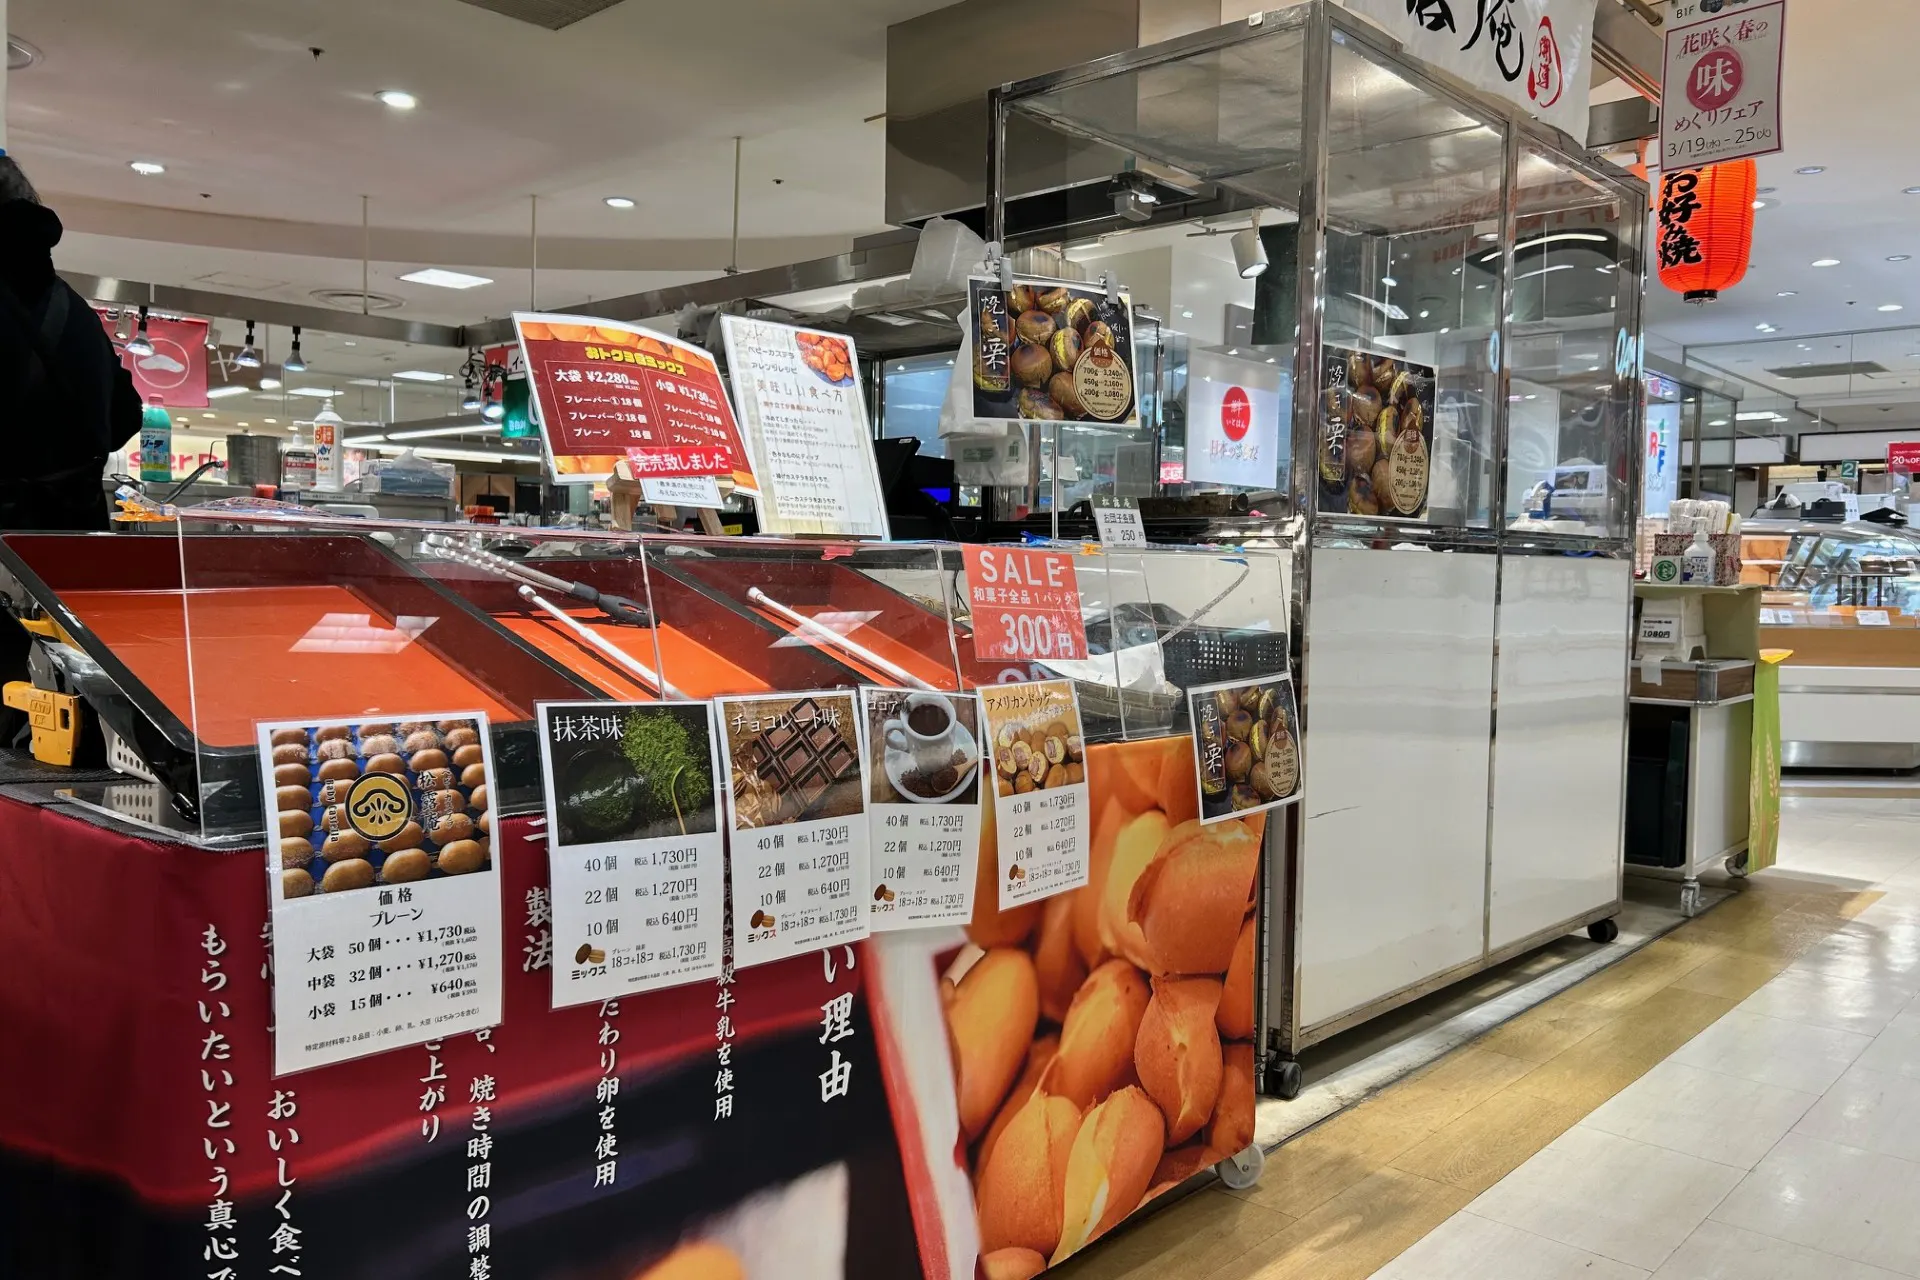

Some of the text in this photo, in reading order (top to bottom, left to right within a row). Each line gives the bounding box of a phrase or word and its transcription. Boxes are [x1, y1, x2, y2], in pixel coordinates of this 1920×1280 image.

[1676, 5, 1696, 19] B1F
[1695, 58, 1735, 101] 味
[555, 369, 582, 383] 大袋
[585, 370, 629, 386] ¥2,280
[634, 453, 729, 473] 完売致しました
[1842, 462, 1855, 476] 2
[979, 549, 1064, 588] SALE
[552, 714, 625, 743] 抹茶味
[731, 705, 841, 735] チョコレート味
[326, 778, 336, 803] Baby
[378, 887, 413, 906] 価格
[369, 908, 425, 928] プレーン
[870, 904, 895, 913] ミックス
[522, 885, 553, 974] 製法
[747, 928, 777, 943] ミックス
[307, 944, 336, 964] 大袋
[307, 973, 336, 992] 中袋
[571, 965, 608, 982] ミックス
[308, 1001, 336, 1021] 小袋
[466, 1074, 497, 1280] 焼き時間の調整
